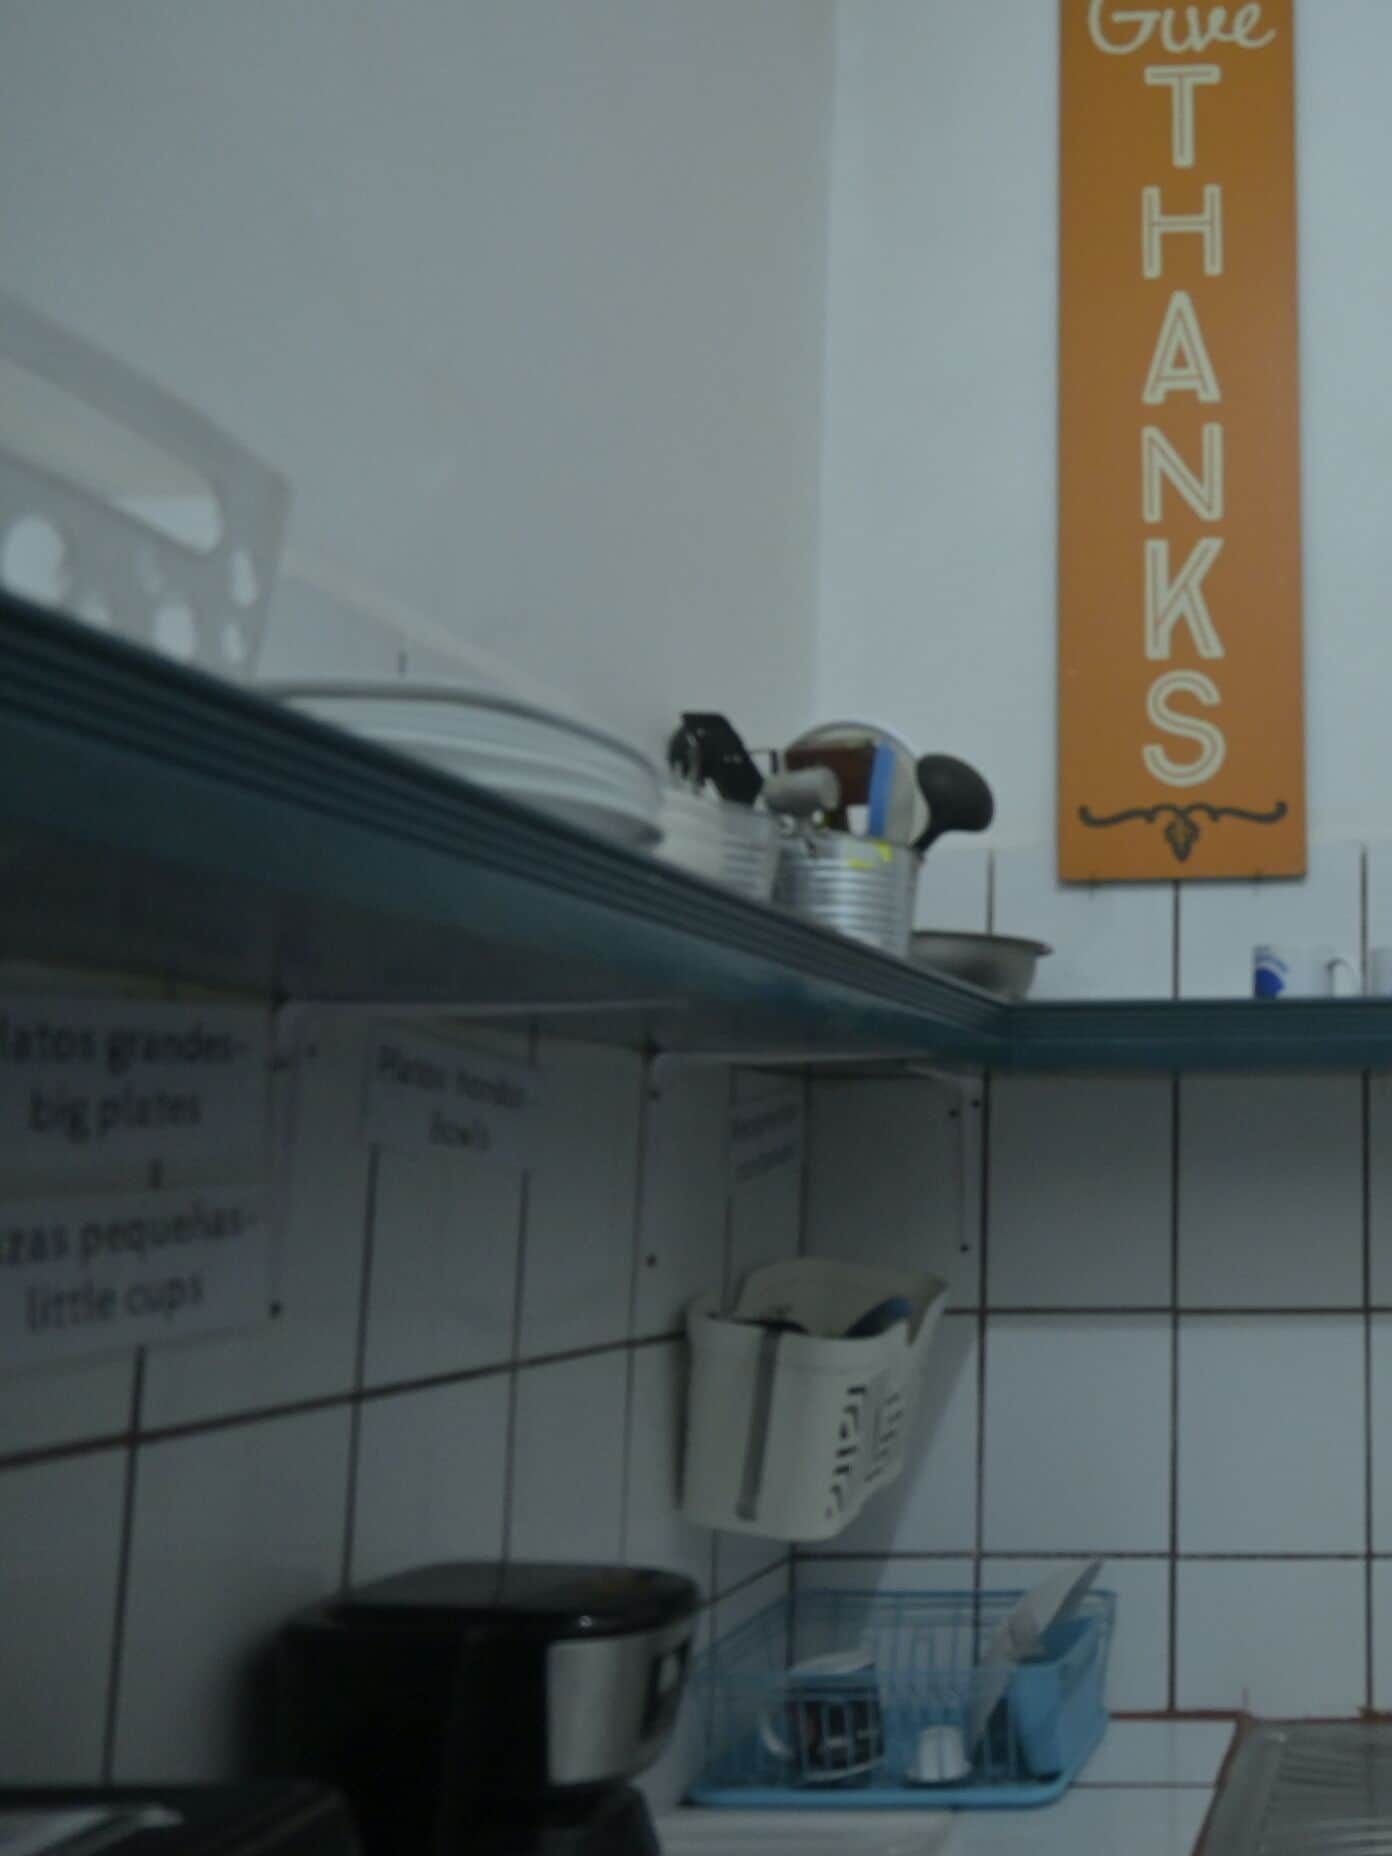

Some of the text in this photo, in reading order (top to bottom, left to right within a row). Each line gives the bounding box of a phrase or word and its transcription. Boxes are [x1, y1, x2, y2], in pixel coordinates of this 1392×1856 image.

[1142, 63, 1227, 788] THANKS
[31, 1082, 201, 1143] big plates
